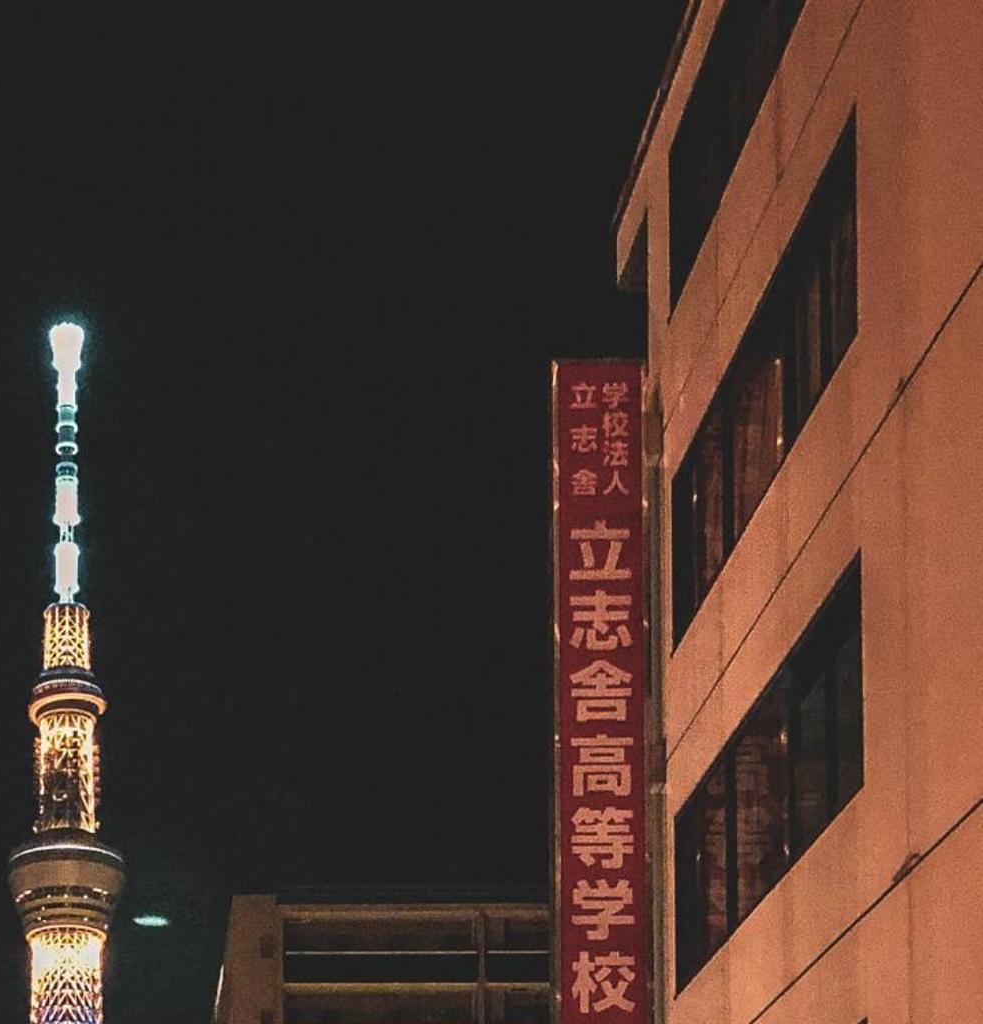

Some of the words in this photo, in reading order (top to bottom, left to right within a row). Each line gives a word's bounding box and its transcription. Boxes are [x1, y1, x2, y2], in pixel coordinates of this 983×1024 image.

[570, 382, 597, 495] 立志舎
[602, 382, 629, 495] 学校法人
[569, 519, 636, 1014] 立志舎高等学校
